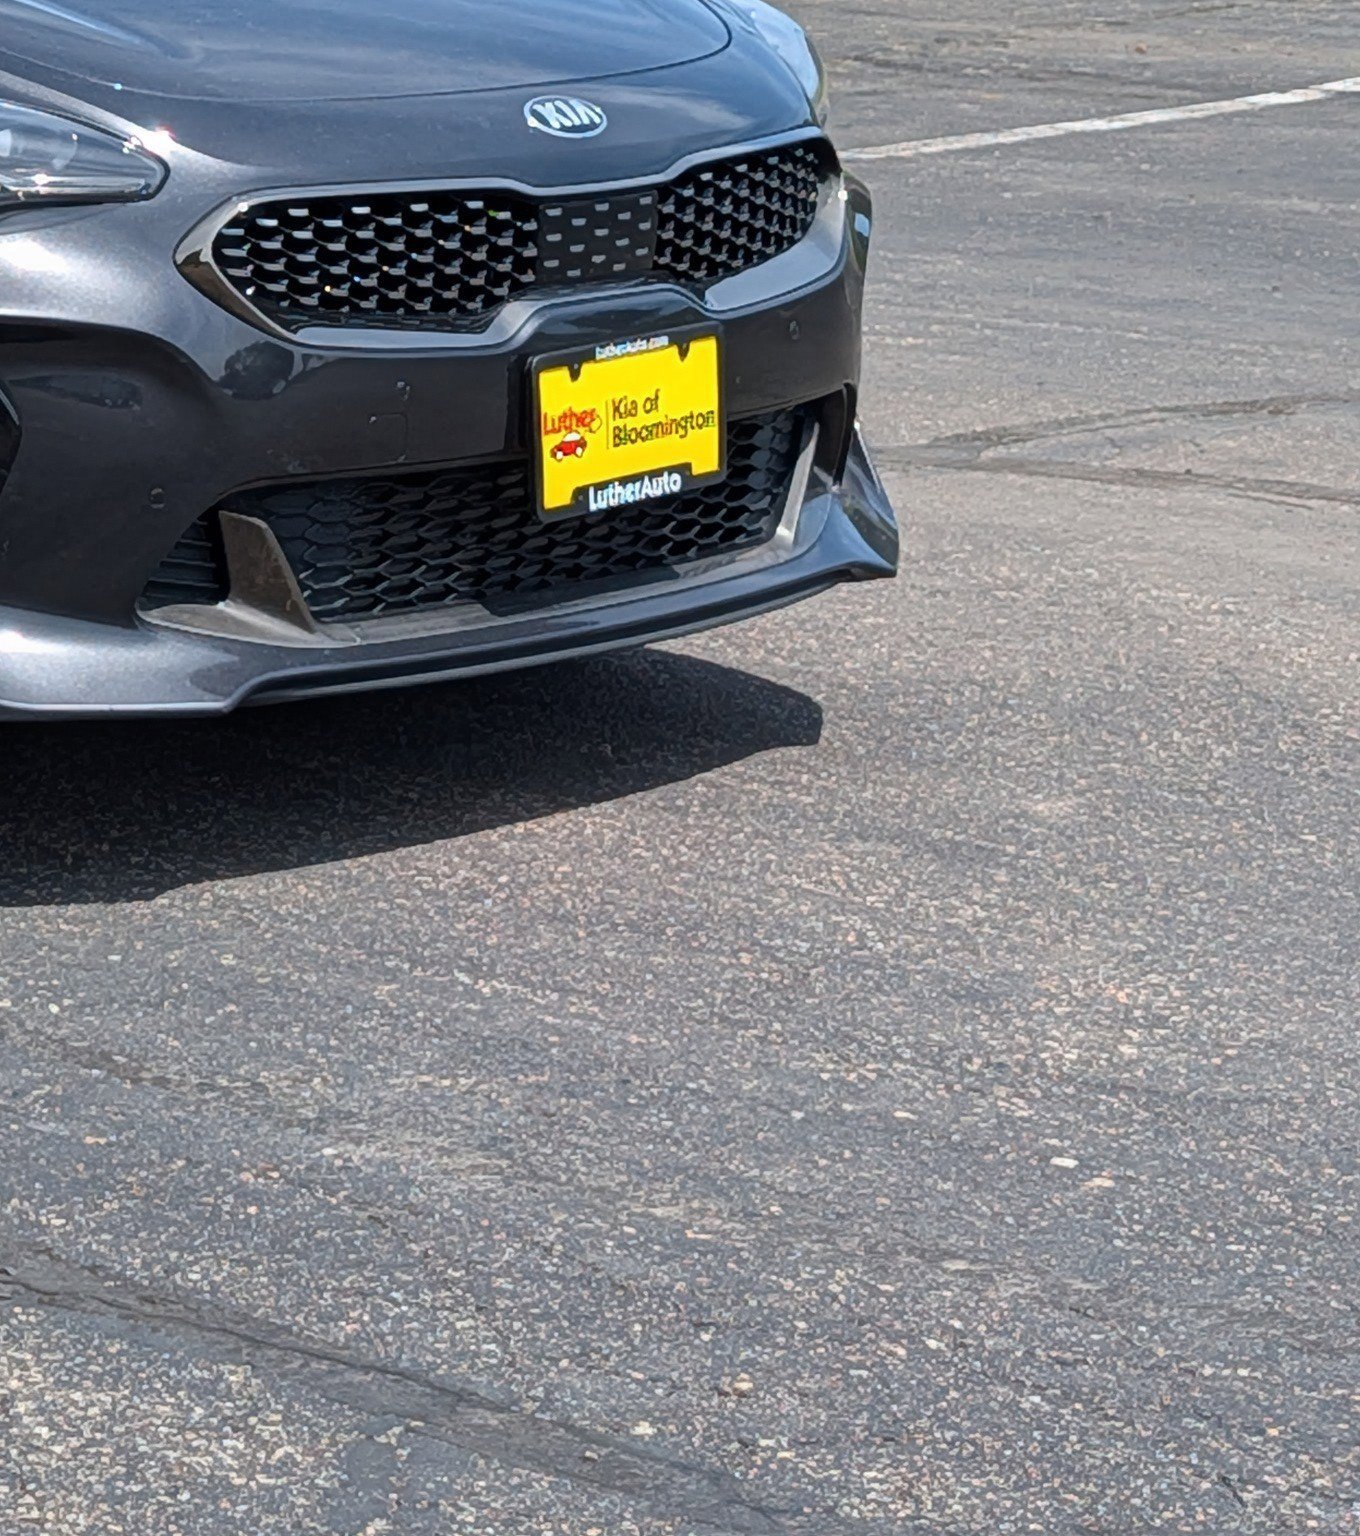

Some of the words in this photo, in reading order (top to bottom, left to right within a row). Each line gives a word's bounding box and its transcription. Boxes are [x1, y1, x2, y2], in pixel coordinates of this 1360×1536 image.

[532, 100, 601, 129] KIA
[542, 406, 597, 436] Luther
[612, 395, 639, 422] Kia
[643, 388, 661, 415] of
[612, 410, 716, 449] Bloomington
[588, 470, 683, 513] LutherAuto
